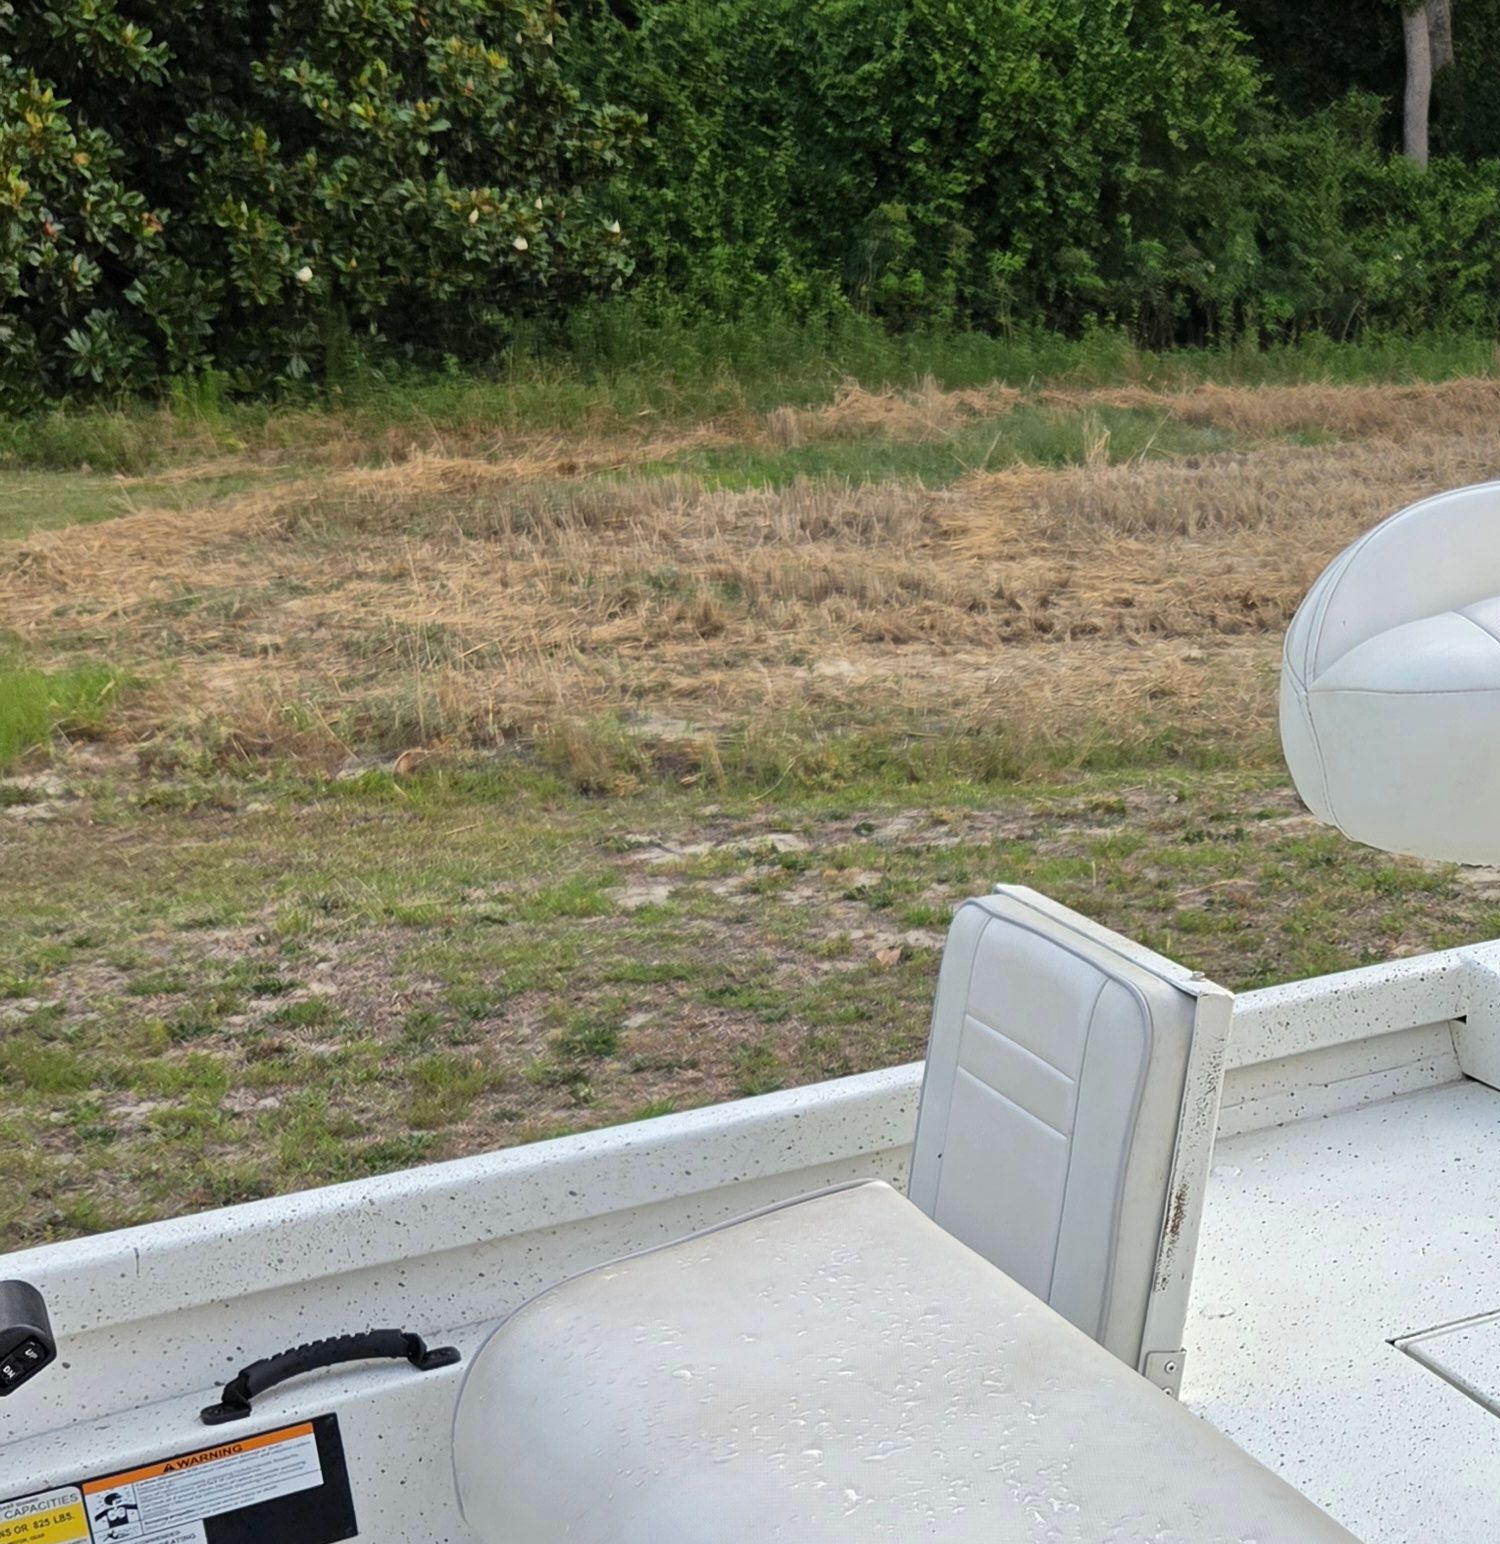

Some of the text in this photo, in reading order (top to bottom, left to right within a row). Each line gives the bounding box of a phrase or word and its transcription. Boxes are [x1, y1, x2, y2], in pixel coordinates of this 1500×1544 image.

[24, 1348, 38, 1360] UP
[3, 1365, 16, 1378] DN
[177, 1443, 244, 1470] WARNING
[4, 1493, 79, 1520] CAPACITIES
[13, 1524, 29, 1535] OR
